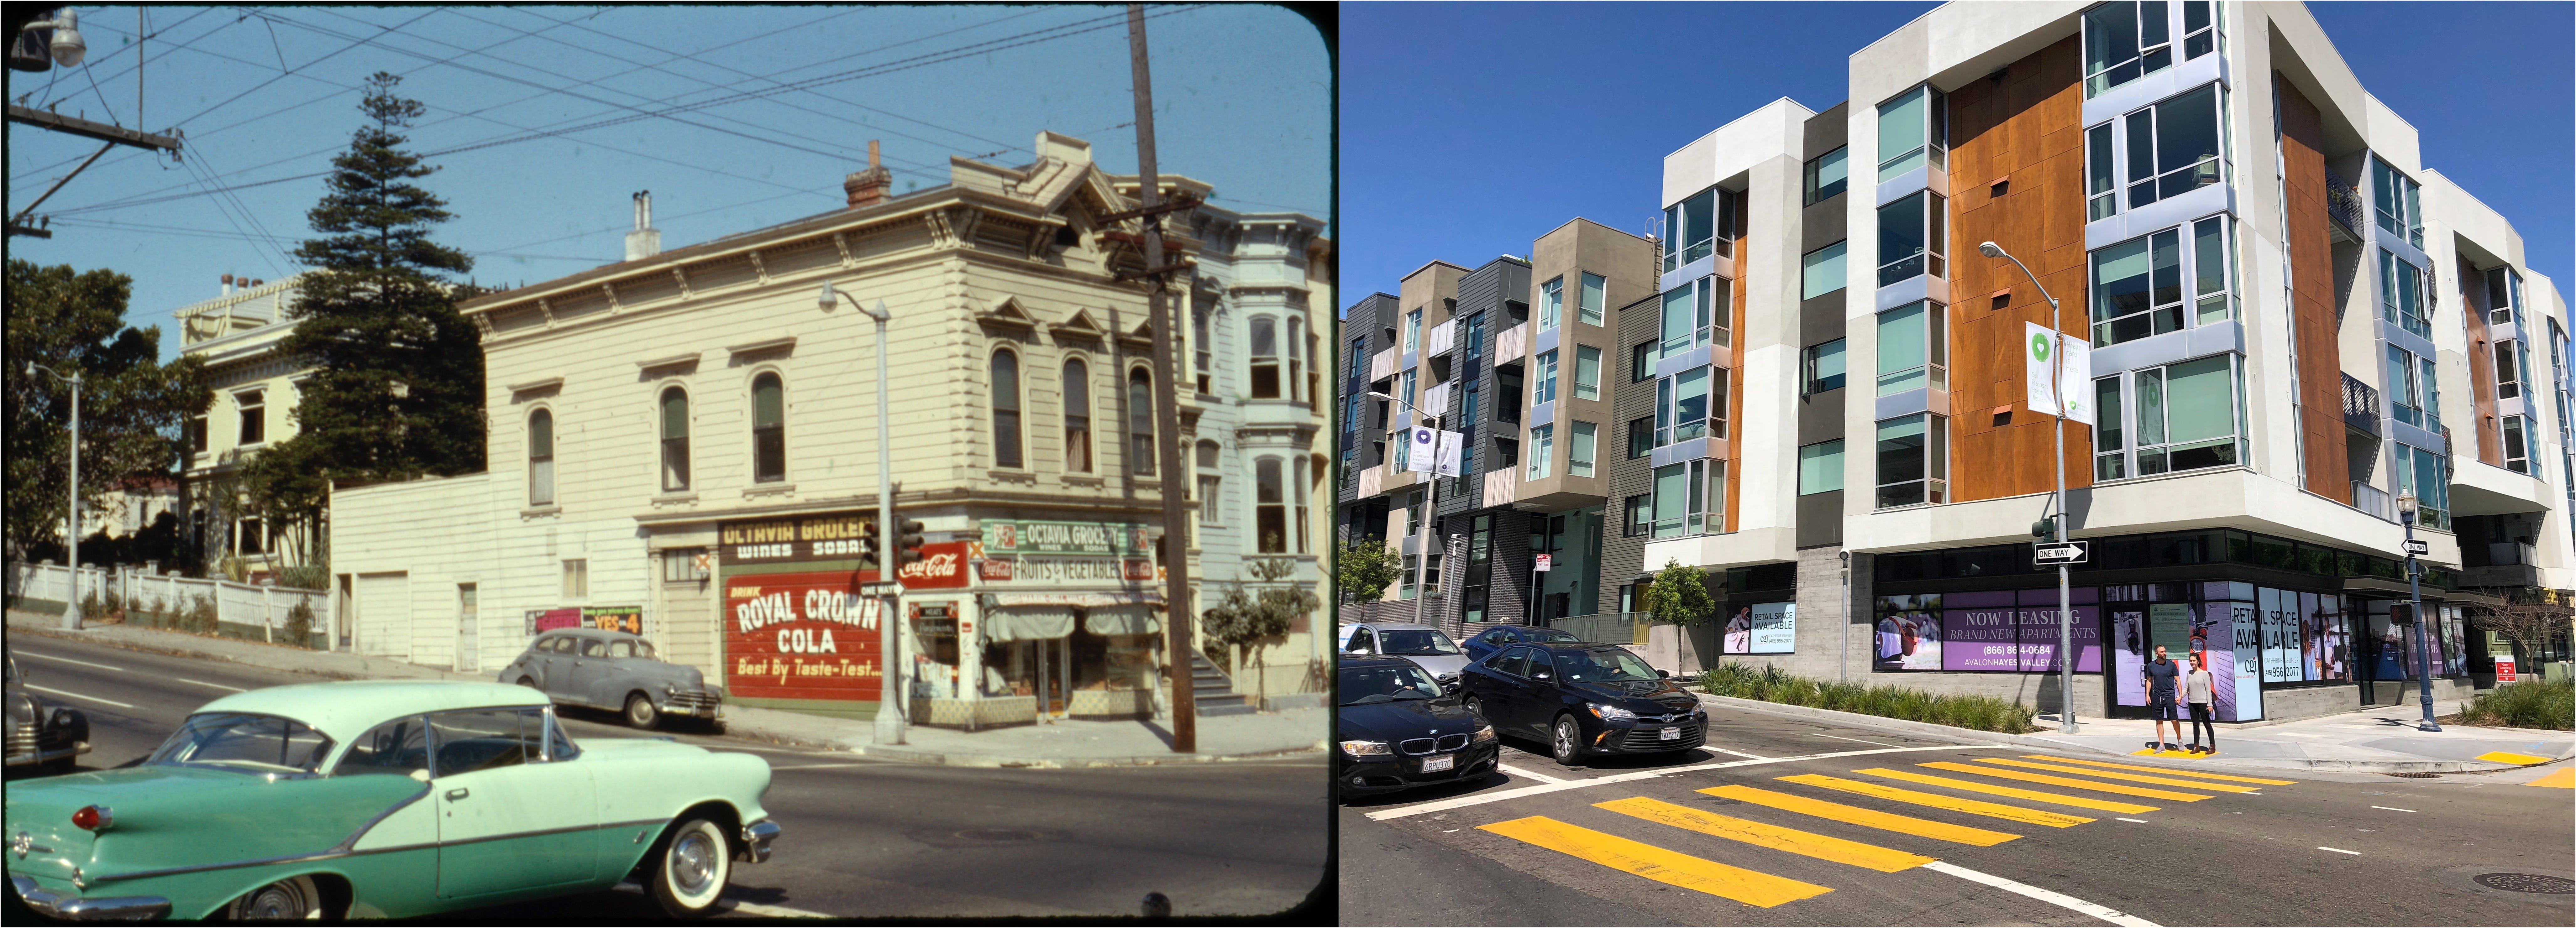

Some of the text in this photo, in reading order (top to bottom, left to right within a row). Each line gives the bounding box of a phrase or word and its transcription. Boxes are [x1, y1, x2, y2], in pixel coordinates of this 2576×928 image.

[2067, 341, 2081, 351] Health
[2032, 379, 2048, 389] Francisco
[724, 516, 875, 544] OCTAVIA GROCER
[1027, 524, 1118, 545] OCTAVIA GROCERY
[737, 544, 792, 559] WINES
[1014, 559, 1121, 579] FRUITS & VEGETABLES
[731, 587, 762, 598] DRINK
[861, 585, 894, 595] ONE WAY
[737, 590, 879, 634] ROYAL CROWN
[1965, 612, 2002, 626] NOW
[2233, 607, 2297, 626] RETAIL SPACE
[595, 615, 620, 631] YES
[626, 613, 639, 634] 4
[1754, 621, 1792, 630] AVAILABLE
[777, 629, 837, 654] COLA
[1950, 629, 1987, 640] BRAND
[1989, 629, 2016, 639] NEW
[2235, 628, 2299, 650] AVAILABLE
[1984, 646, 2005, 656] (866)
[738, 658, 768, 675] Best
[772, 659, 789, 685] By
[1425, 760, 1451, 770] 6RPU370
